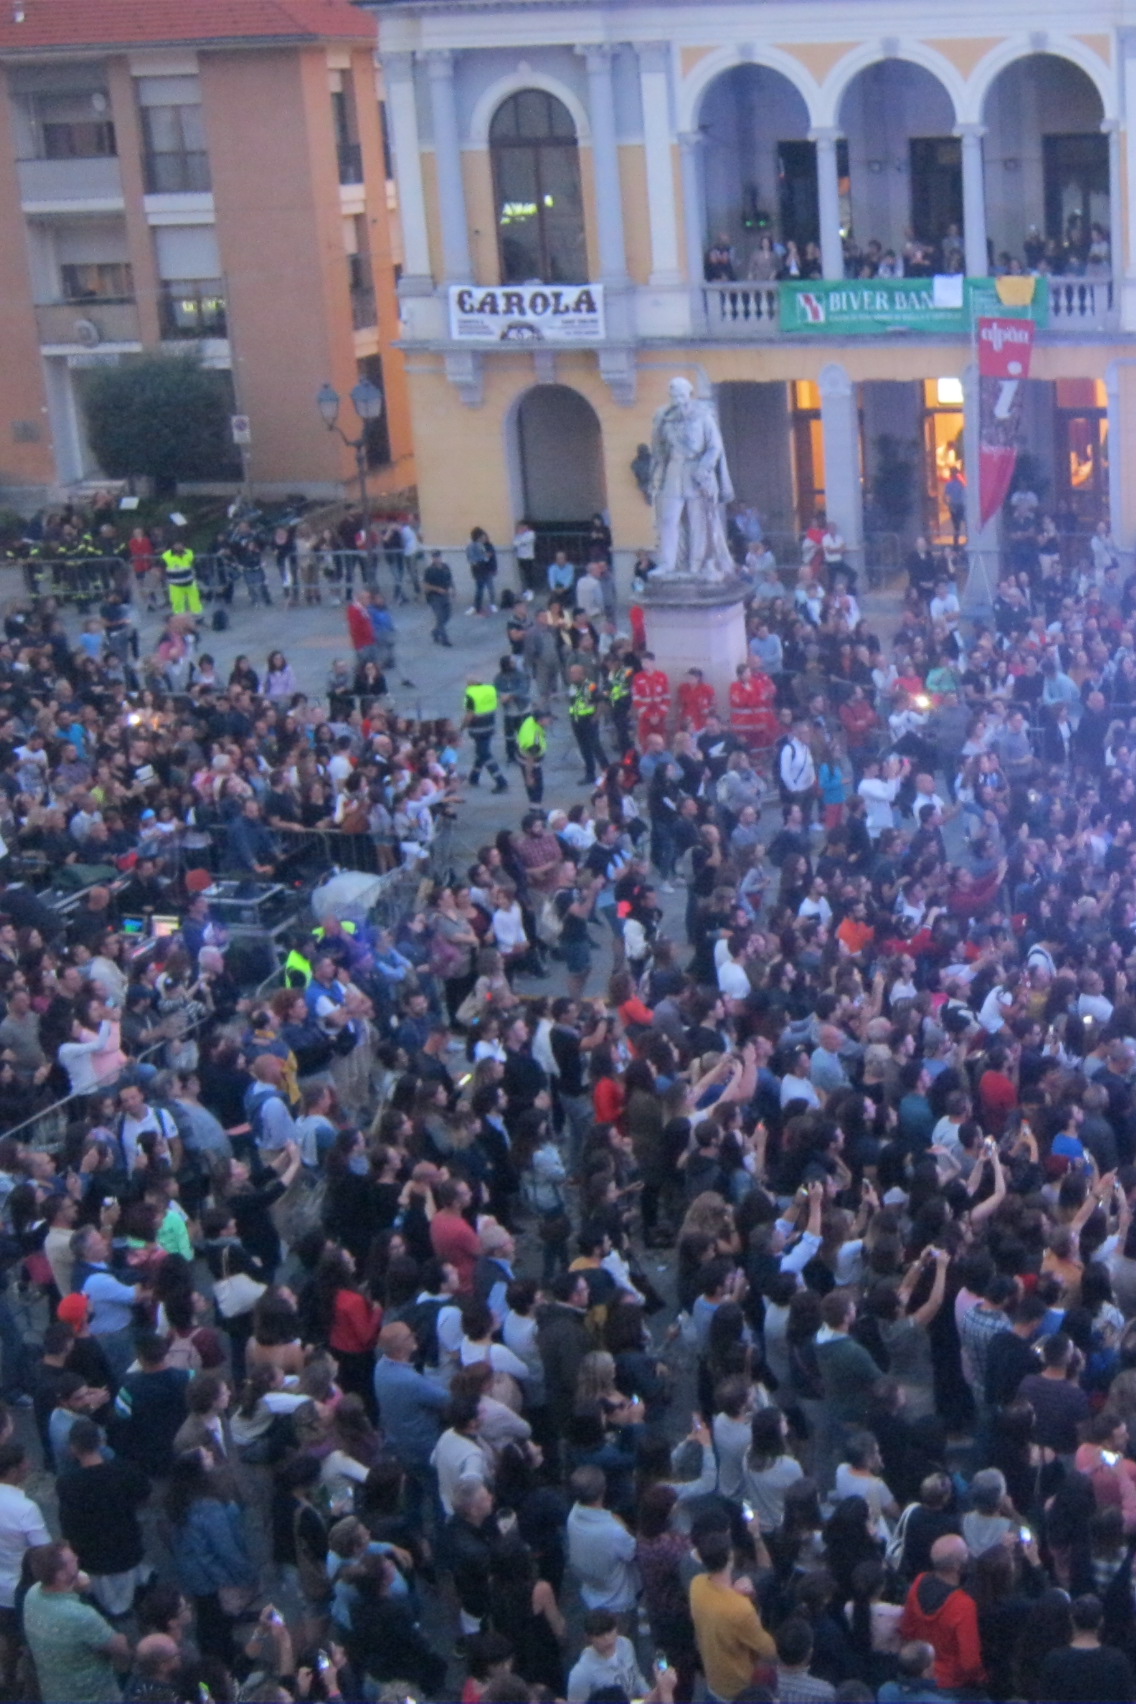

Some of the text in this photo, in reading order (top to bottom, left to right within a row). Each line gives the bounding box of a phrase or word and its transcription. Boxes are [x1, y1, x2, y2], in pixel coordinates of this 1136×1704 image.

[457, 289, 597, 316] CAROLA
[829, 289, 935, 312] BIVER BAN
